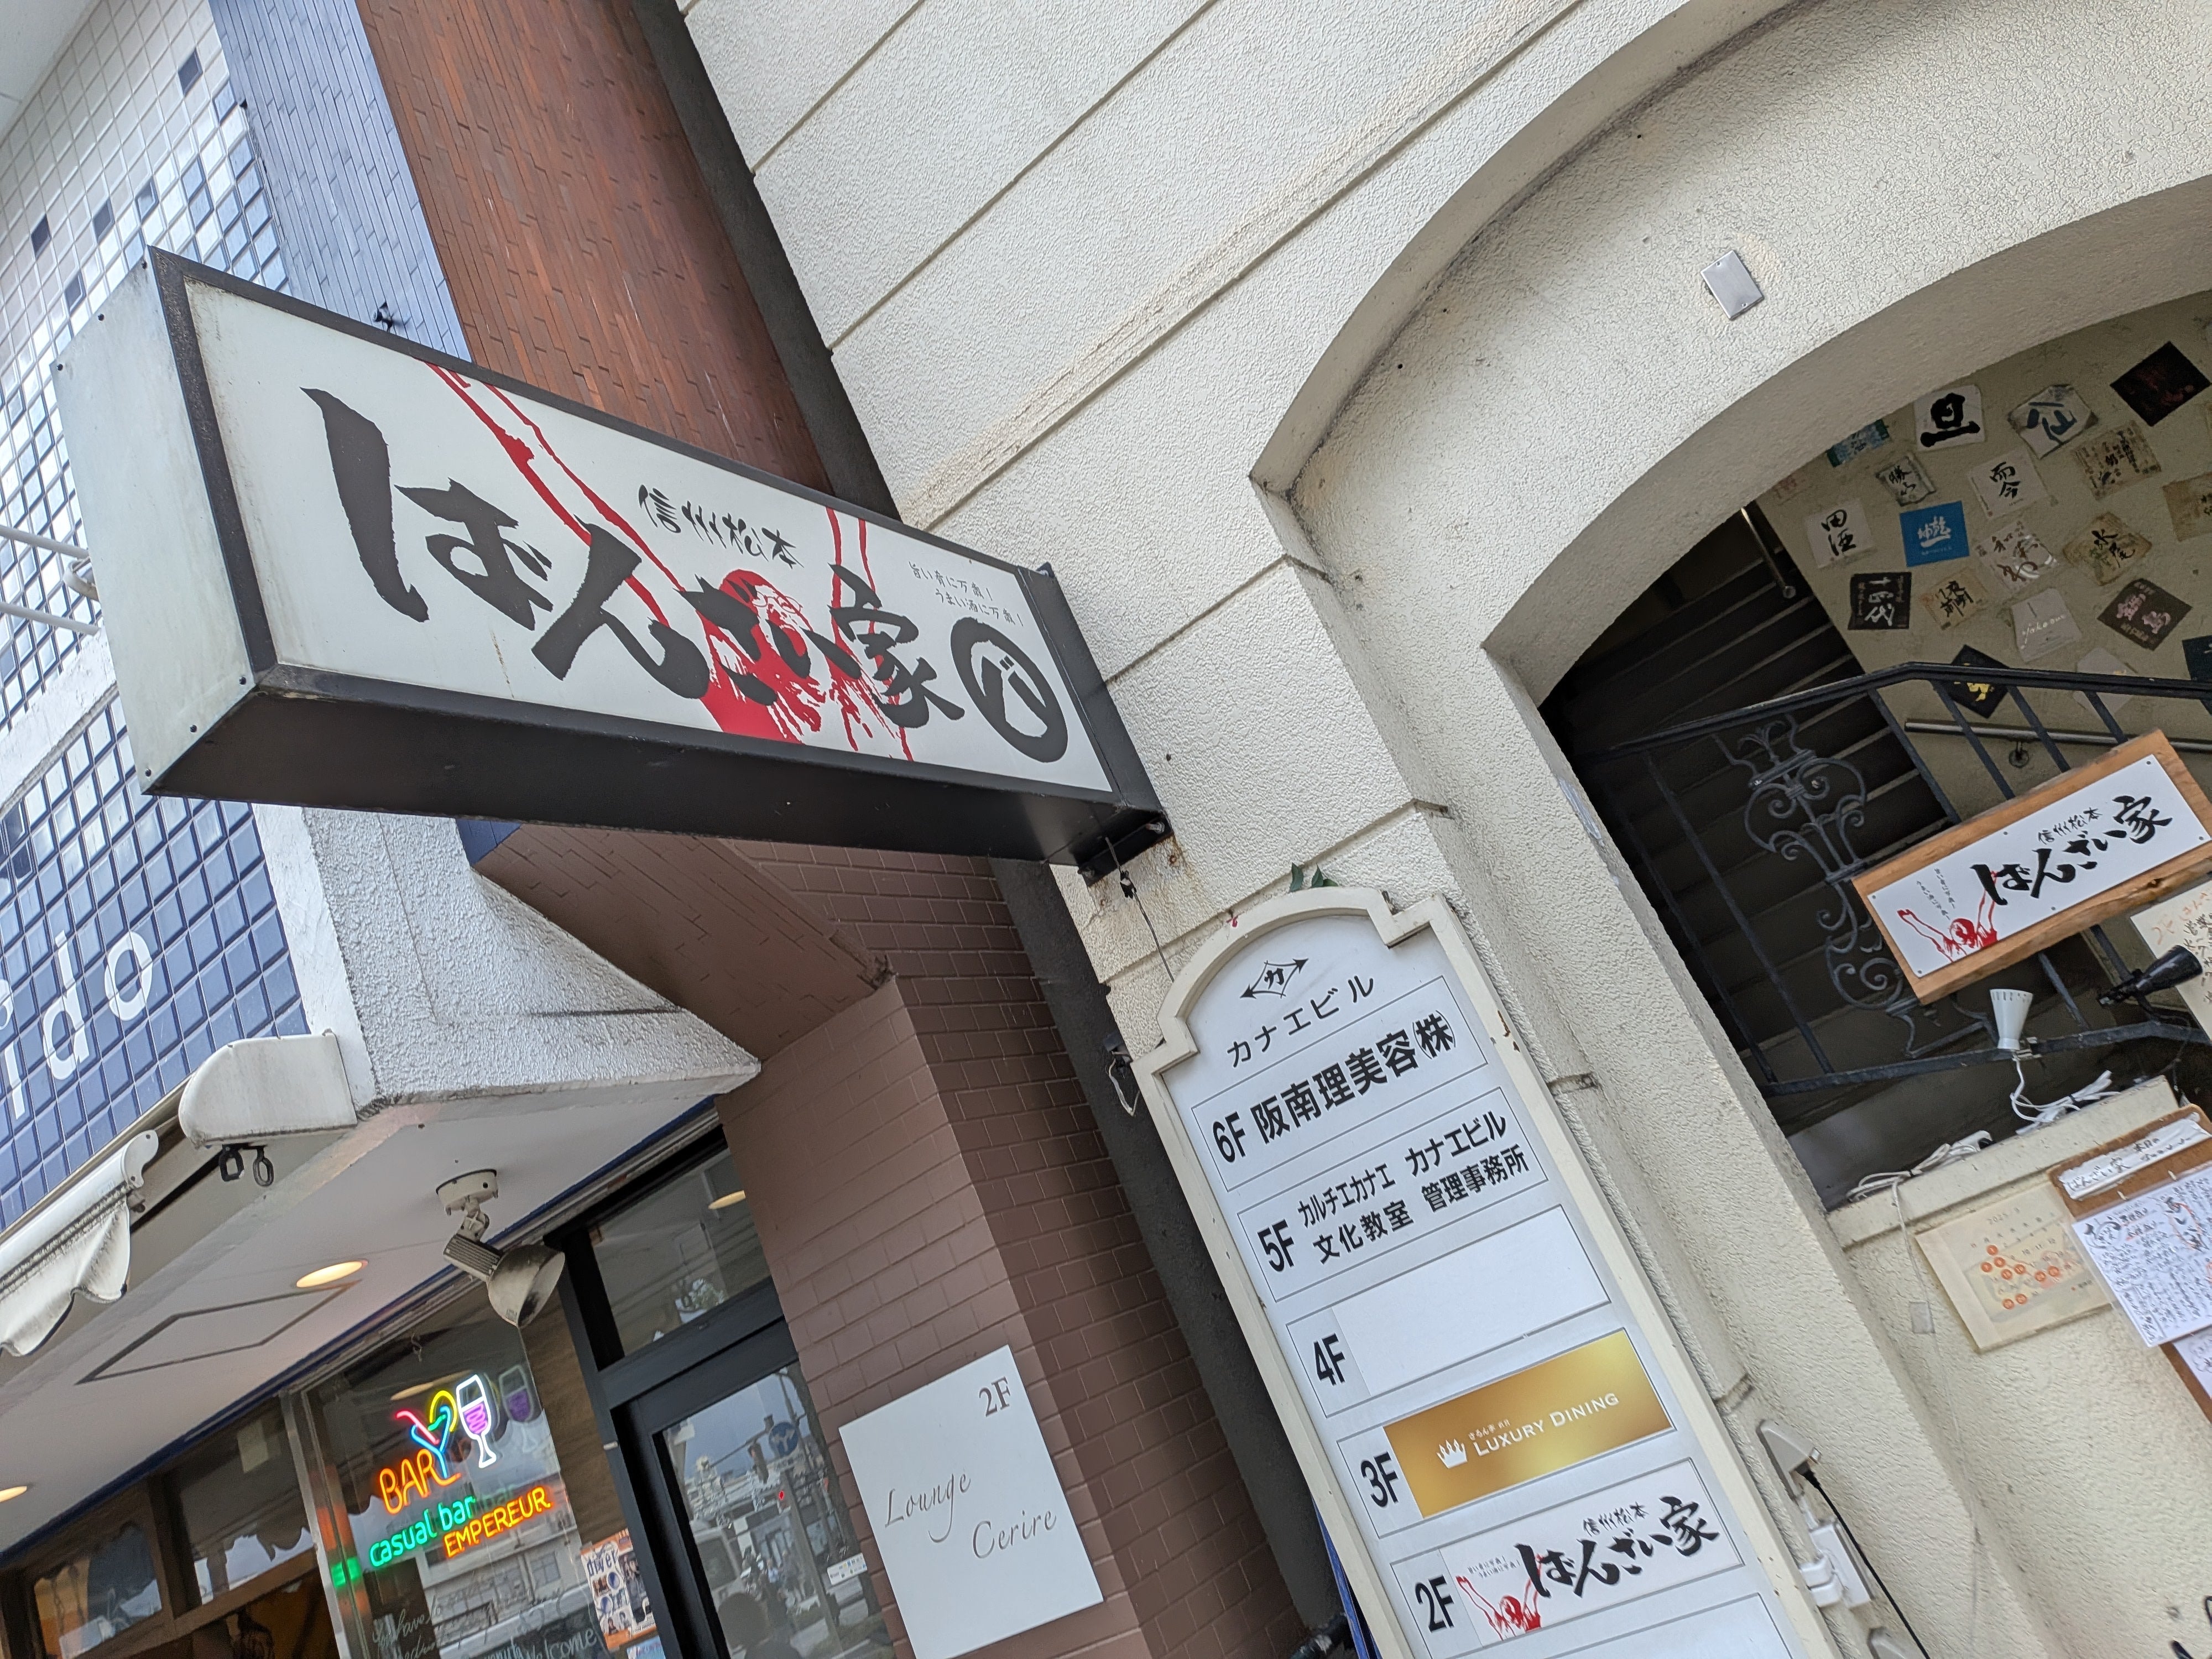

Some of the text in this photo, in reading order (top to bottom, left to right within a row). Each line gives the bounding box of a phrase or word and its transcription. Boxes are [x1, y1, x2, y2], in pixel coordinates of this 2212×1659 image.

[639, 484, 804, 568] 信州松本
[1971, 795, 2173, 905] ばんざい家
[2037, 807, 2101, 844] 信州松本
[1227, 975, 1374, 1068] カナエビル
[1212, 1112, 1247, 1163] 6F
[1405, 1110, 1507, 1177] カナエビル
[1257, 1144, 1530, 1273] 5F 文化教室 管理事務所
[1314, 1333, 1347, 1387] 4F
[979, 1376, 1011, 1417] 2F
[379, 1448, 461, 1515] BAR
[1360, 1392, 1619, 1509] 3F LUXURY DINING
[369, 1496, 476, 1567] casual bar
[444, 1486, 551, 1558] EMPEREUR
[885, 1473, 971, 1543] Lounge
[1415, 1495, 1720, 1634] 2F ばんざい家
